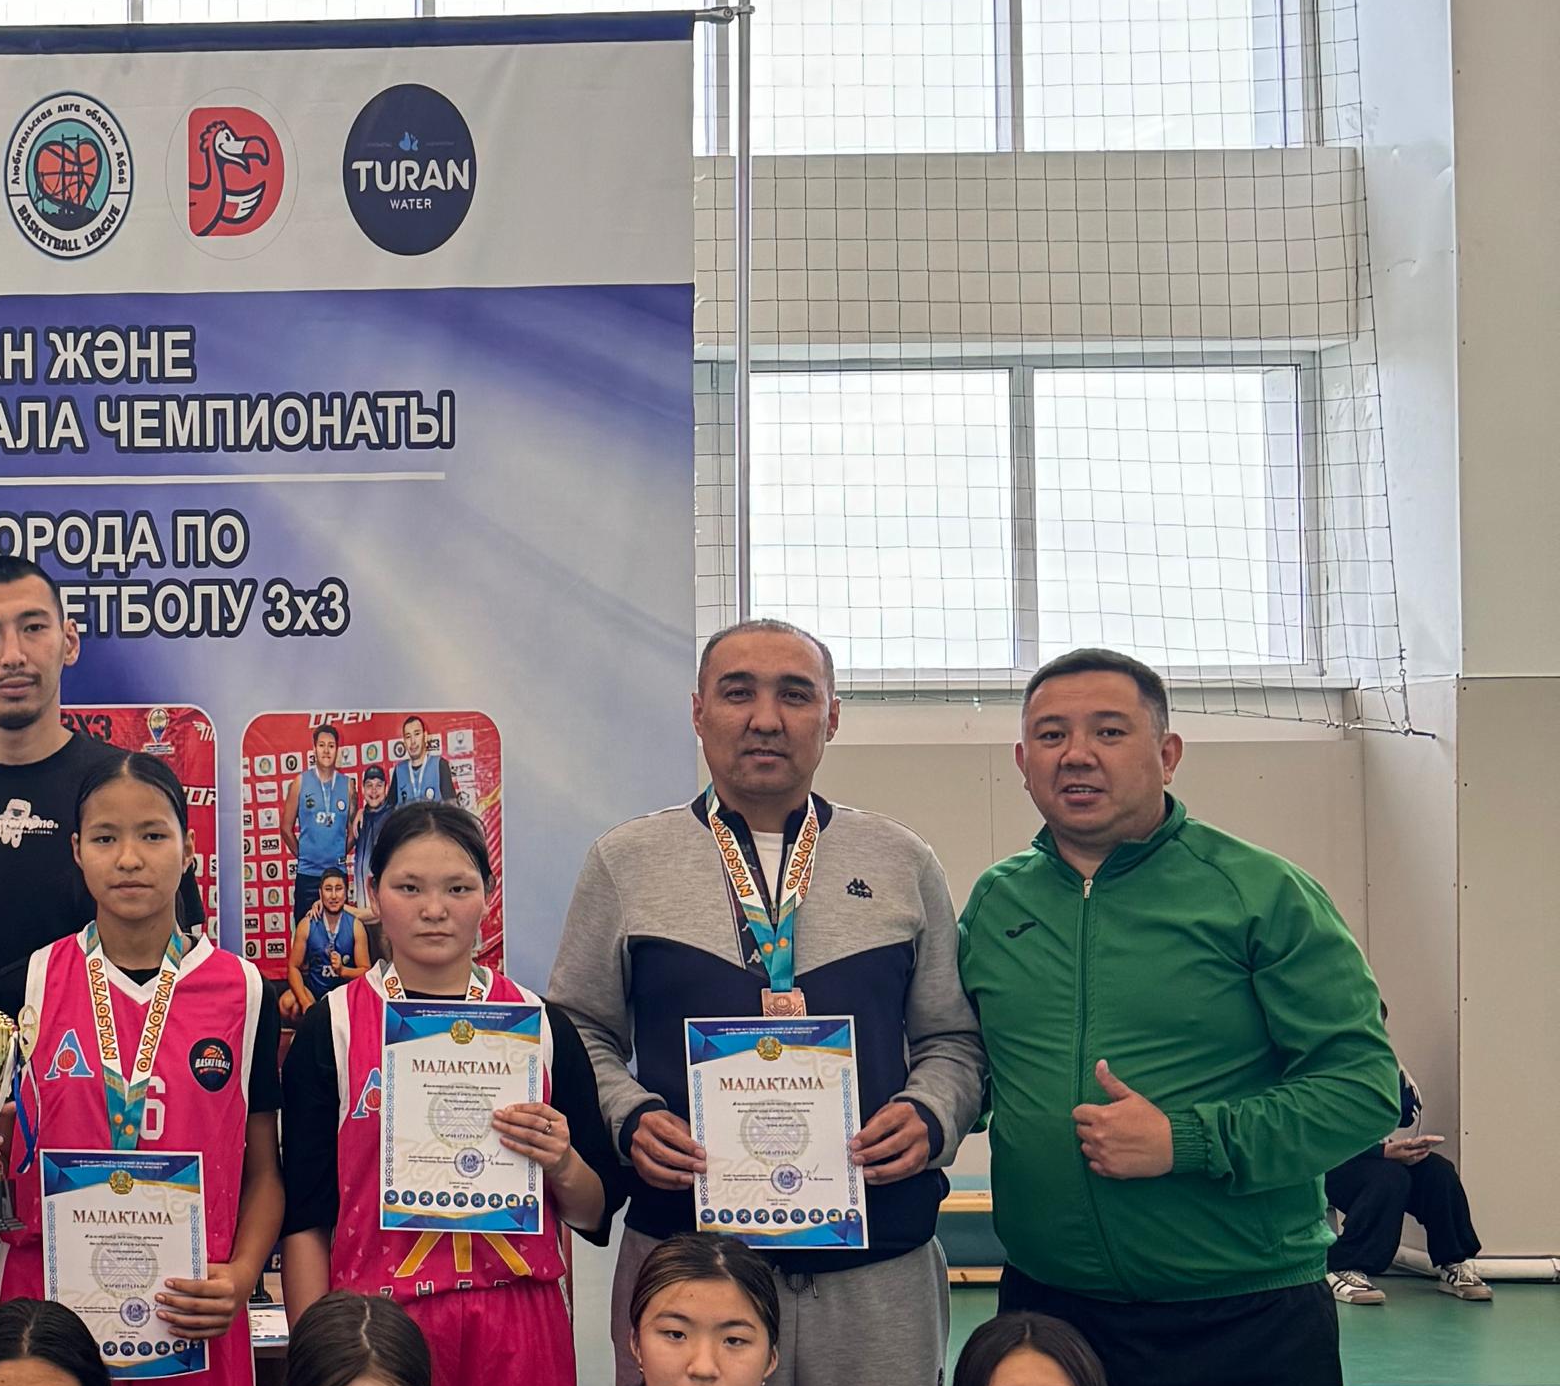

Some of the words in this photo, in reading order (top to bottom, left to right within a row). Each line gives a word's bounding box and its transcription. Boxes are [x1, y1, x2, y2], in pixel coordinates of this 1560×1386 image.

[57, 103, 81, 113] лига
[85, 108, 118, 146] области
[115, 151, 128, 184] Абай
[351, 158, 470, 192] TURAN
[17, 204, 81, 252] BASKETBALL
[84, 204, 122, 247] LEAGUE
[389, 198, 432, 210] WATER
[48, 330, 194, 381] ЖӘНЕ
[98, 395, 453, 449] ЧЕМПИОНАТЫ
[176, 515, 247, 565] ПО
[87, 958, 119, 1061] QAZAQSTAN
[137, 970, 176, 1074] QAZAQSTAN
[411, 1058, 512, 1077] МАДАҚТАМА
[719, 1076, 825, 1094] МАДАҚТАМА
[72, 1209, 173, 1228] МАДАҚТАМА
